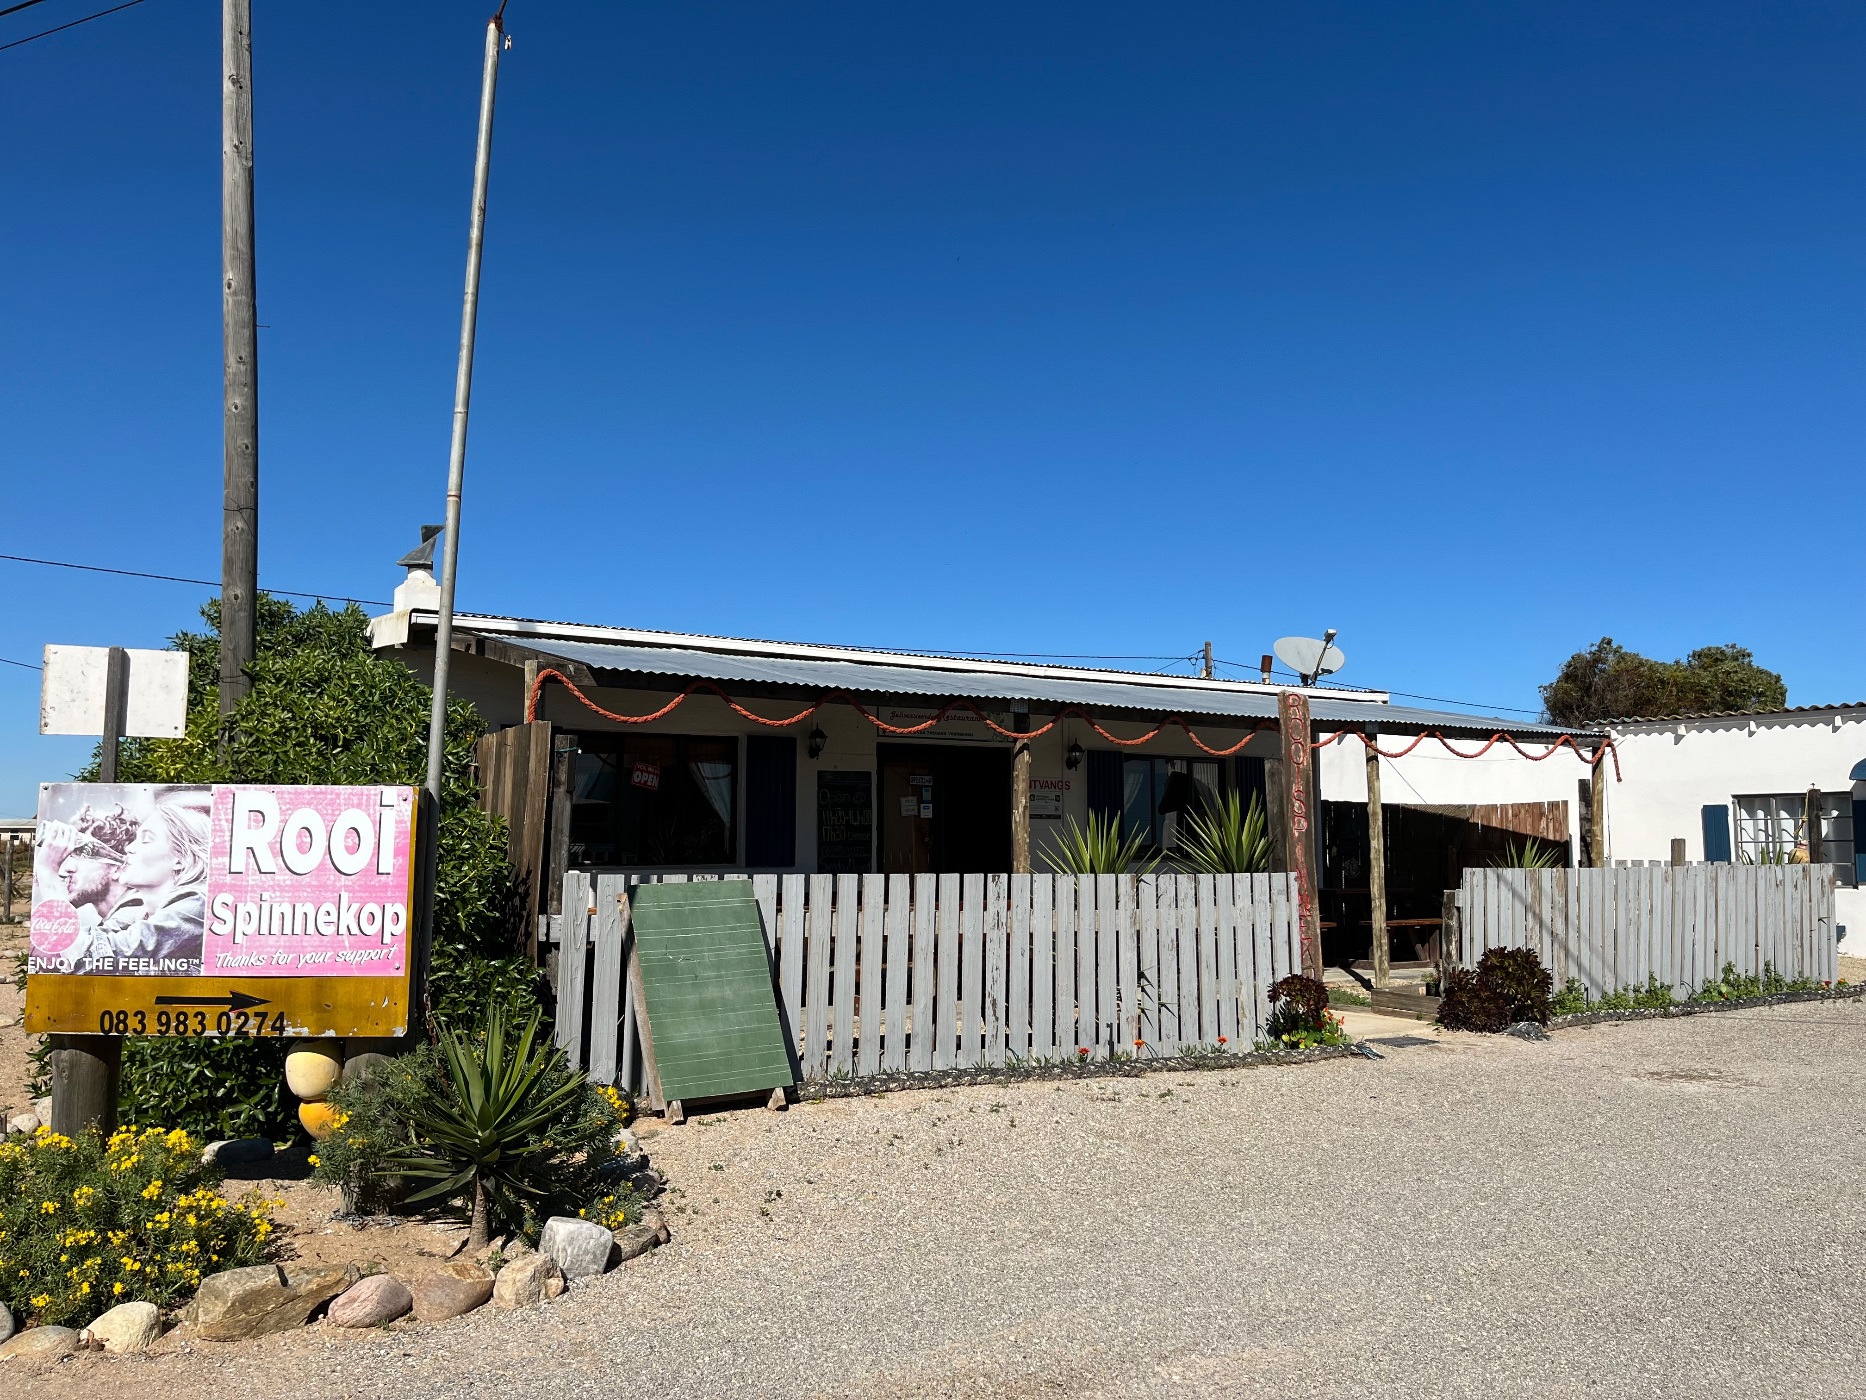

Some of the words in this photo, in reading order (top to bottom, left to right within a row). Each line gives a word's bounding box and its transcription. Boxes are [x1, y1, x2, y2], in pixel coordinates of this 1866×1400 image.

[633, 771, 659, 787] OPEN
[228, 790, 397, 876] Rooi
[31, 917, 78, 934] Coca-Cola
[209, 892, 407, 945] Spinnekop
[28, 956, 77, 970] ENJOY
[83, 957, 115, 970] THE
[216, 951, 267, 969] Thanks
[271, 949, 296, 966] for
[296, 949, 334, 969] your
[335, 943, 399, 964] support
[99, 1009, 147, 1036] 083
[156, 1010, 207, 1036] 983
[216, 1010, 286, 1037] 0274
